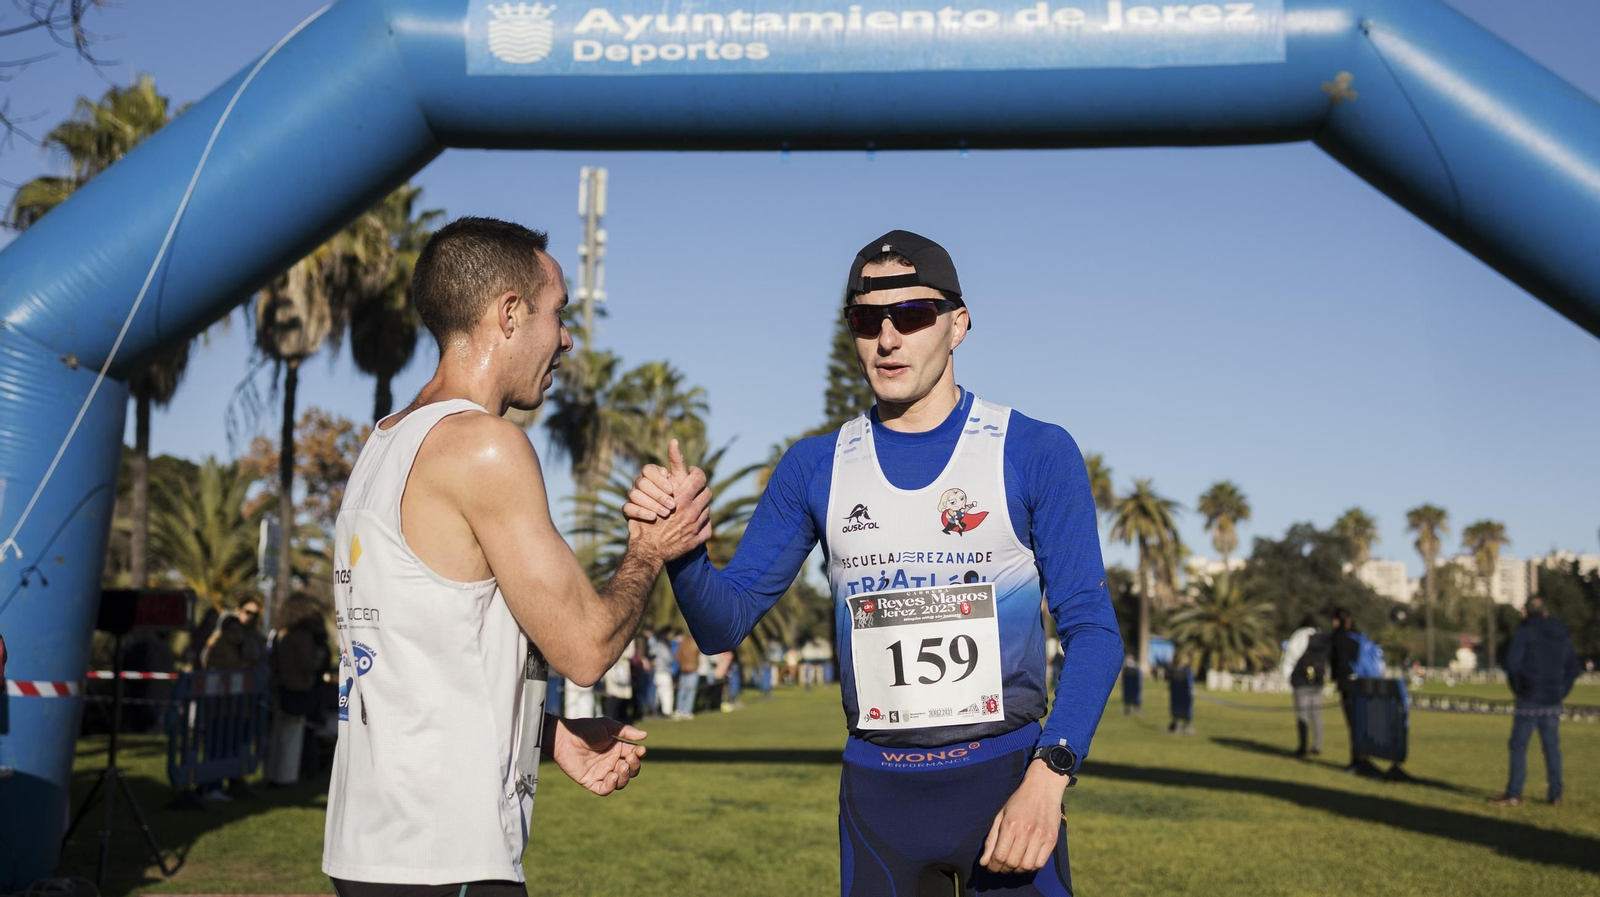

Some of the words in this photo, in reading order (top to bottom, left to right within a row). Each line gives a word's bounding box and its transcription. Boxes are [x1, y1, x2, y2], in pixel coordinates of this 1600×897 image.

[573, 4, 1000, 41] Ayuntamiento
[1014, 2, 1086, 28] de
[1100, 1, 1256, 32] Jerez
[573, 39, 770, 66] Deportes
[877, 597, 926, 611] Reyes
[931, 591, 989, 605] Magos
[881, 608, 917, 619] Jerez
[921, 603, 956, 615] 2025
[886, 634, 979, 688] 159
[881, 756, 970, 769] PERFORMANCE
[882, 748, 968, 763] WONG
